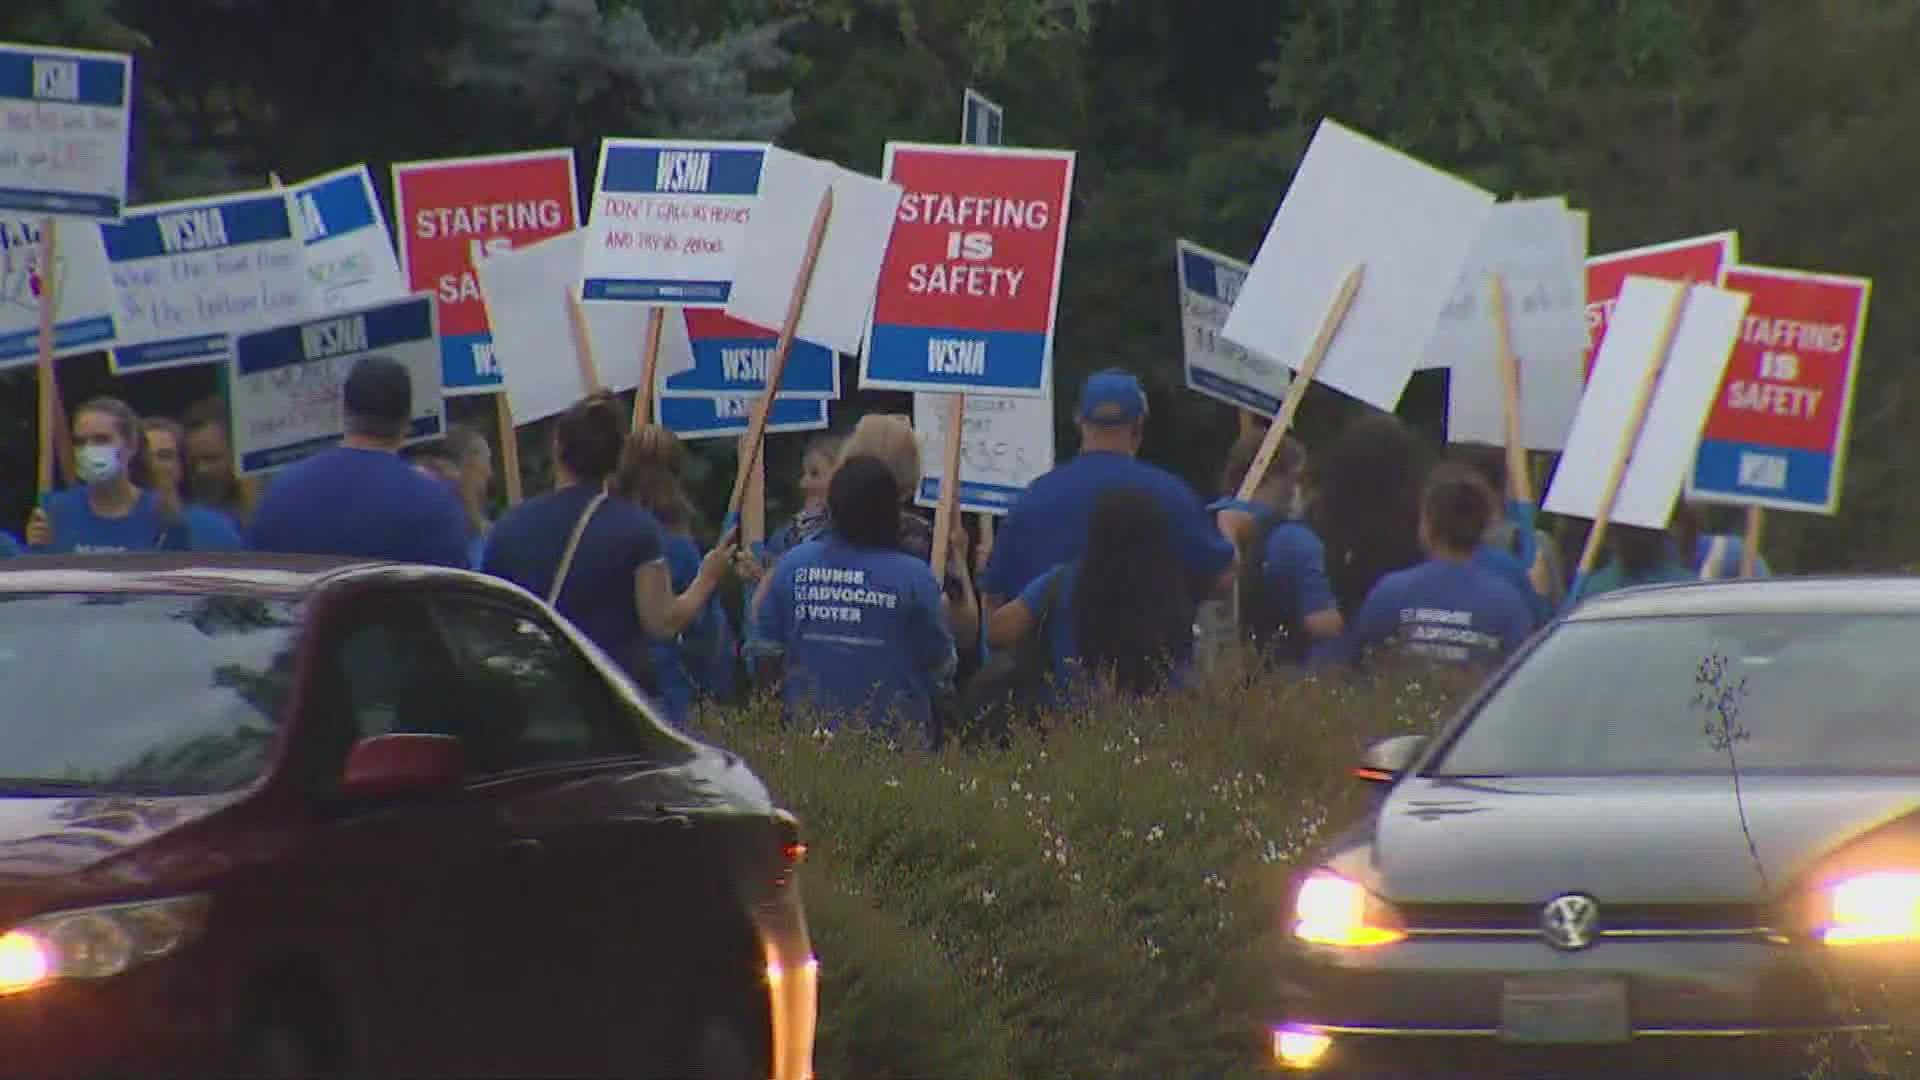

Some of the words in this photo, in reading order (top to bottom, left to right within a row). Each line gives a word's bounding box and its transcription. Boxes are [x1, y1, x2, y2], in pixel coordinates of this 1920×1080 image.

[656, 152, 711, 192] WSNA
[157, 207, 229, 253] WSNA
[416, 199, 562, 239] STAFFING
[898, 193, 1049, 230] STAFFING
[947, 231, 993, 260] IS
[908, 263, 1025, 298] SAFETY
[302, 315, 368, 361] WSNA
[1743, 315, 1846, 353] TAFFING
[928, 337, 988, 376] WSNA
[1758, 350, 1800, 380] IS
[1728, 381, 1823, 418] SAFETY
[808, 568, 864, 584] NURSE
[807, 585, 898, 609] ADVOCATE
[808, 604, 862, 623] VOTER
